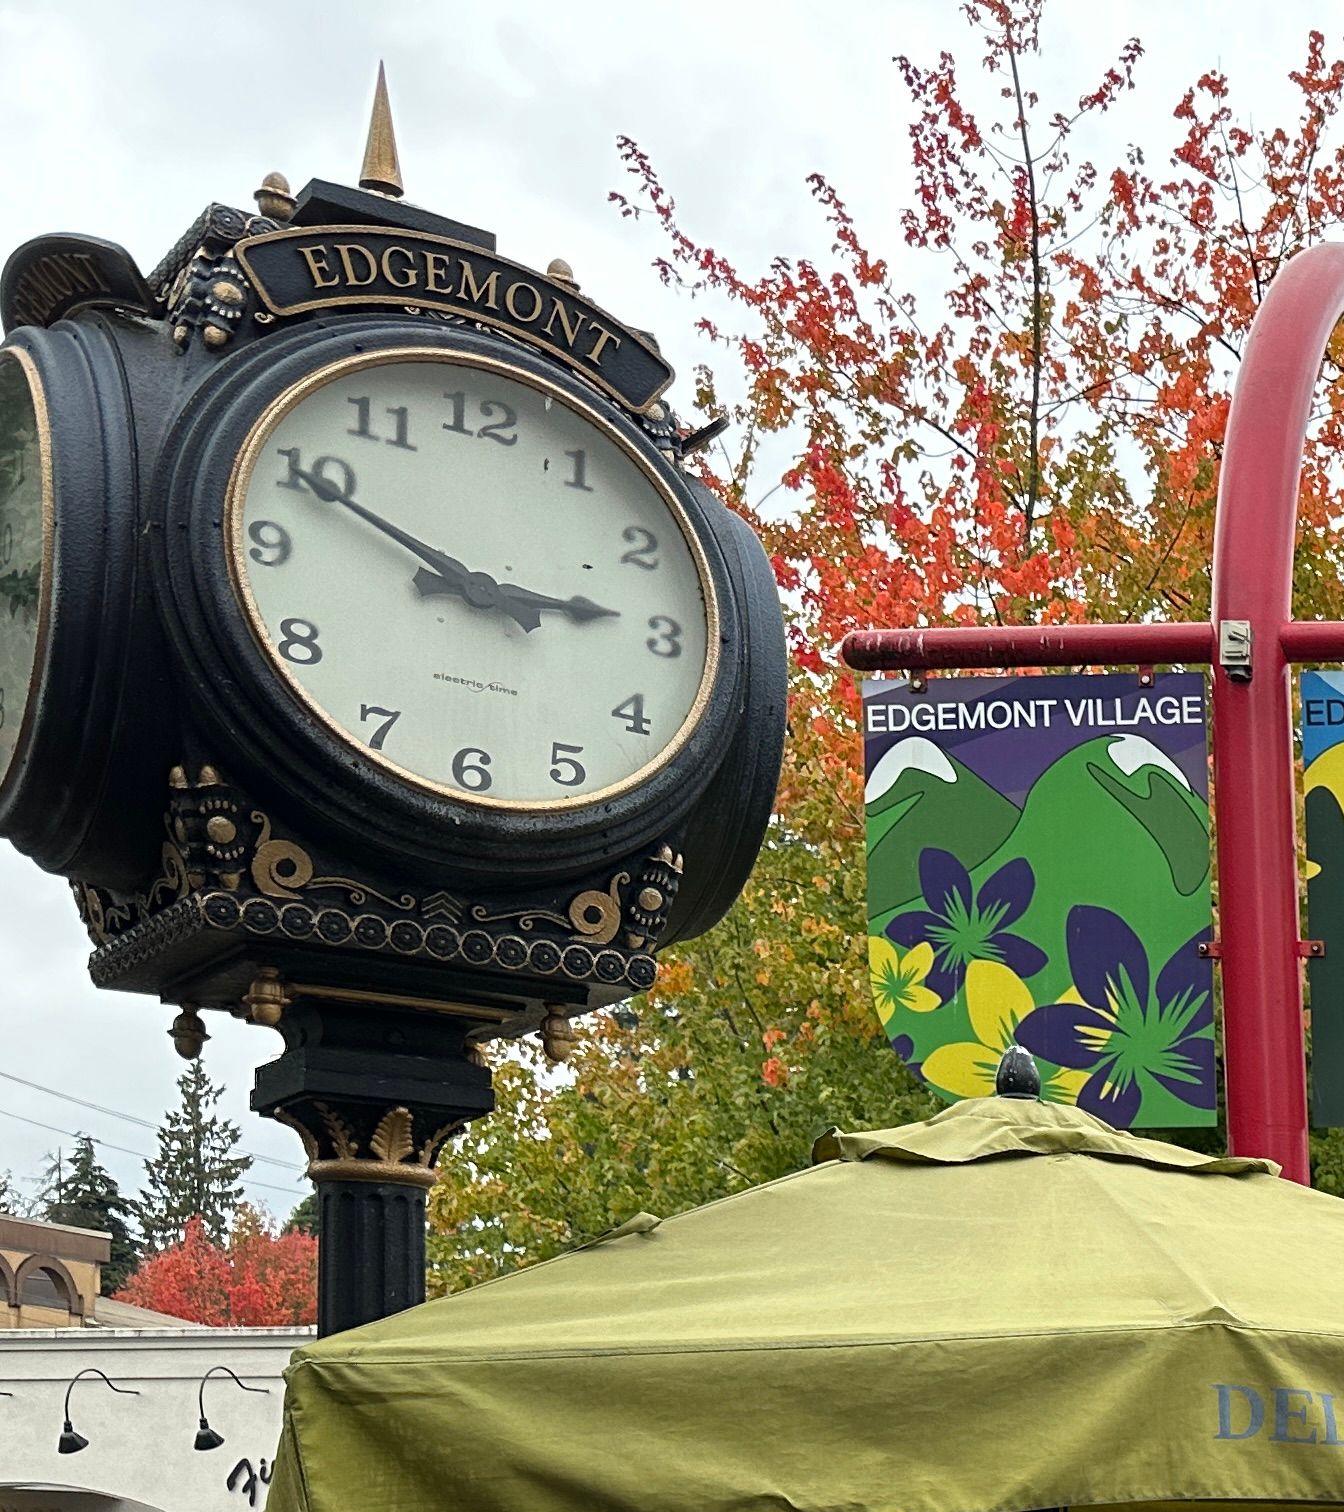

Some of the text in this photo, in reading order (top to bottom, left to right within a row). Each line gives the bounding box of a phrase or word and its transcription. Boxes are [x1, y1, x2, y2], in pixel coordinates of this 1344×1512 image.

[298, 242, 625, 367] EDGEMONT
[347, 395, 418, 452] 11
[442, 391, 519, 446] 12
[275, 447, 357, 502] 10
[564, 448, 594, 492] 1
[247, 519, 292, 567] 9
[620, 525, 660, 571] 2
[277, 617, 323, 666] 8
[646, 615, 682, 659] 3
[433, 673, 518, 696] electric time
[360, 702, 400, 750] 7
[610, 692, 652, 737] 4
[866, 695, 1202, 733] EDGEMONT VILLAGE
[451, 745, 493, 793] 6
[549, 741, 587, 788] 5
